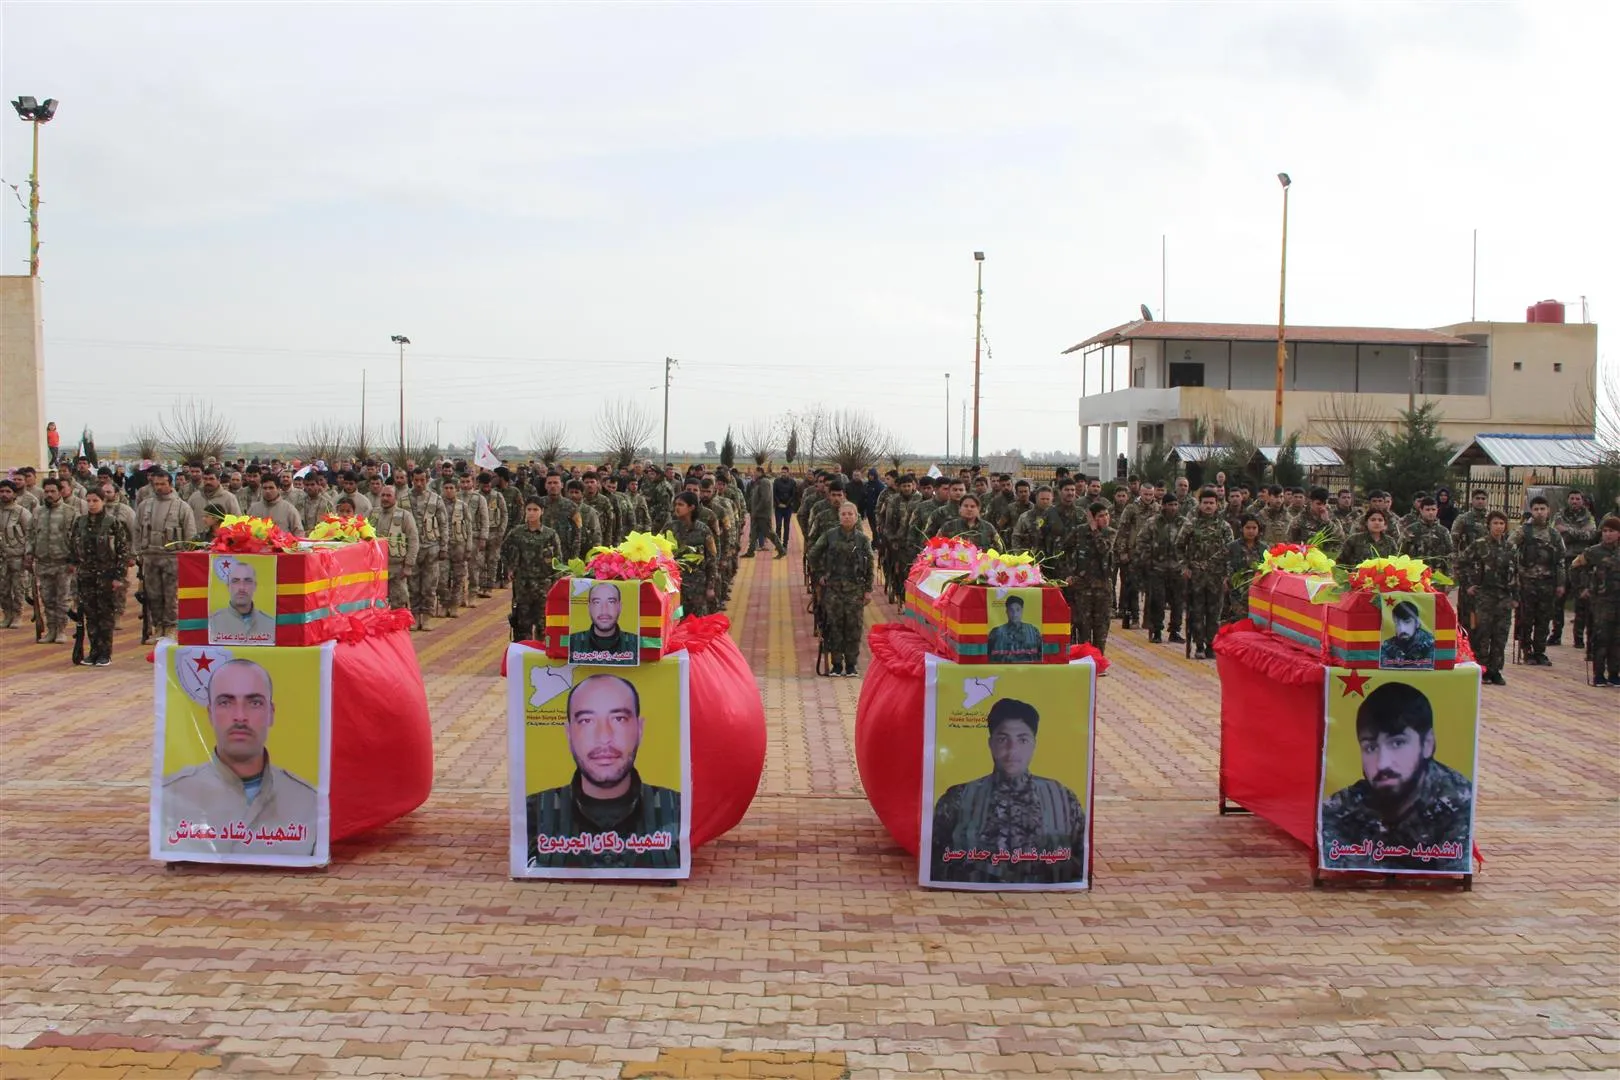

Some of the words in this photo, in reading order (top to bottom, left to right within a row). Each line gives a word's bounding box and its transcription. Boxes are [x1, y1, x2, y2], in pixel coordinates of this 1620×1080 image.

[168, 818, 217, 844] عماش
[220, 821, 253, 845] رشاد
[256, 822, 307, 845] الشهيد
[592, 830, 624, 853] راكان
[627, 831, 671, 852] الشهيد
[537, 832, 592, 855] الجربوع
[942, 846, 966, 862] حسن
[1329, 838, 1373, 861] الحسن
[1372, 840, 1411, 861] حسن
[1411, 841, 1463, 862] الشهيد
[991, 847, 1011, 866] علي
[1010, 847, 1038, 863] غسان
[1039, 847, 1071, 864] الشهيد
